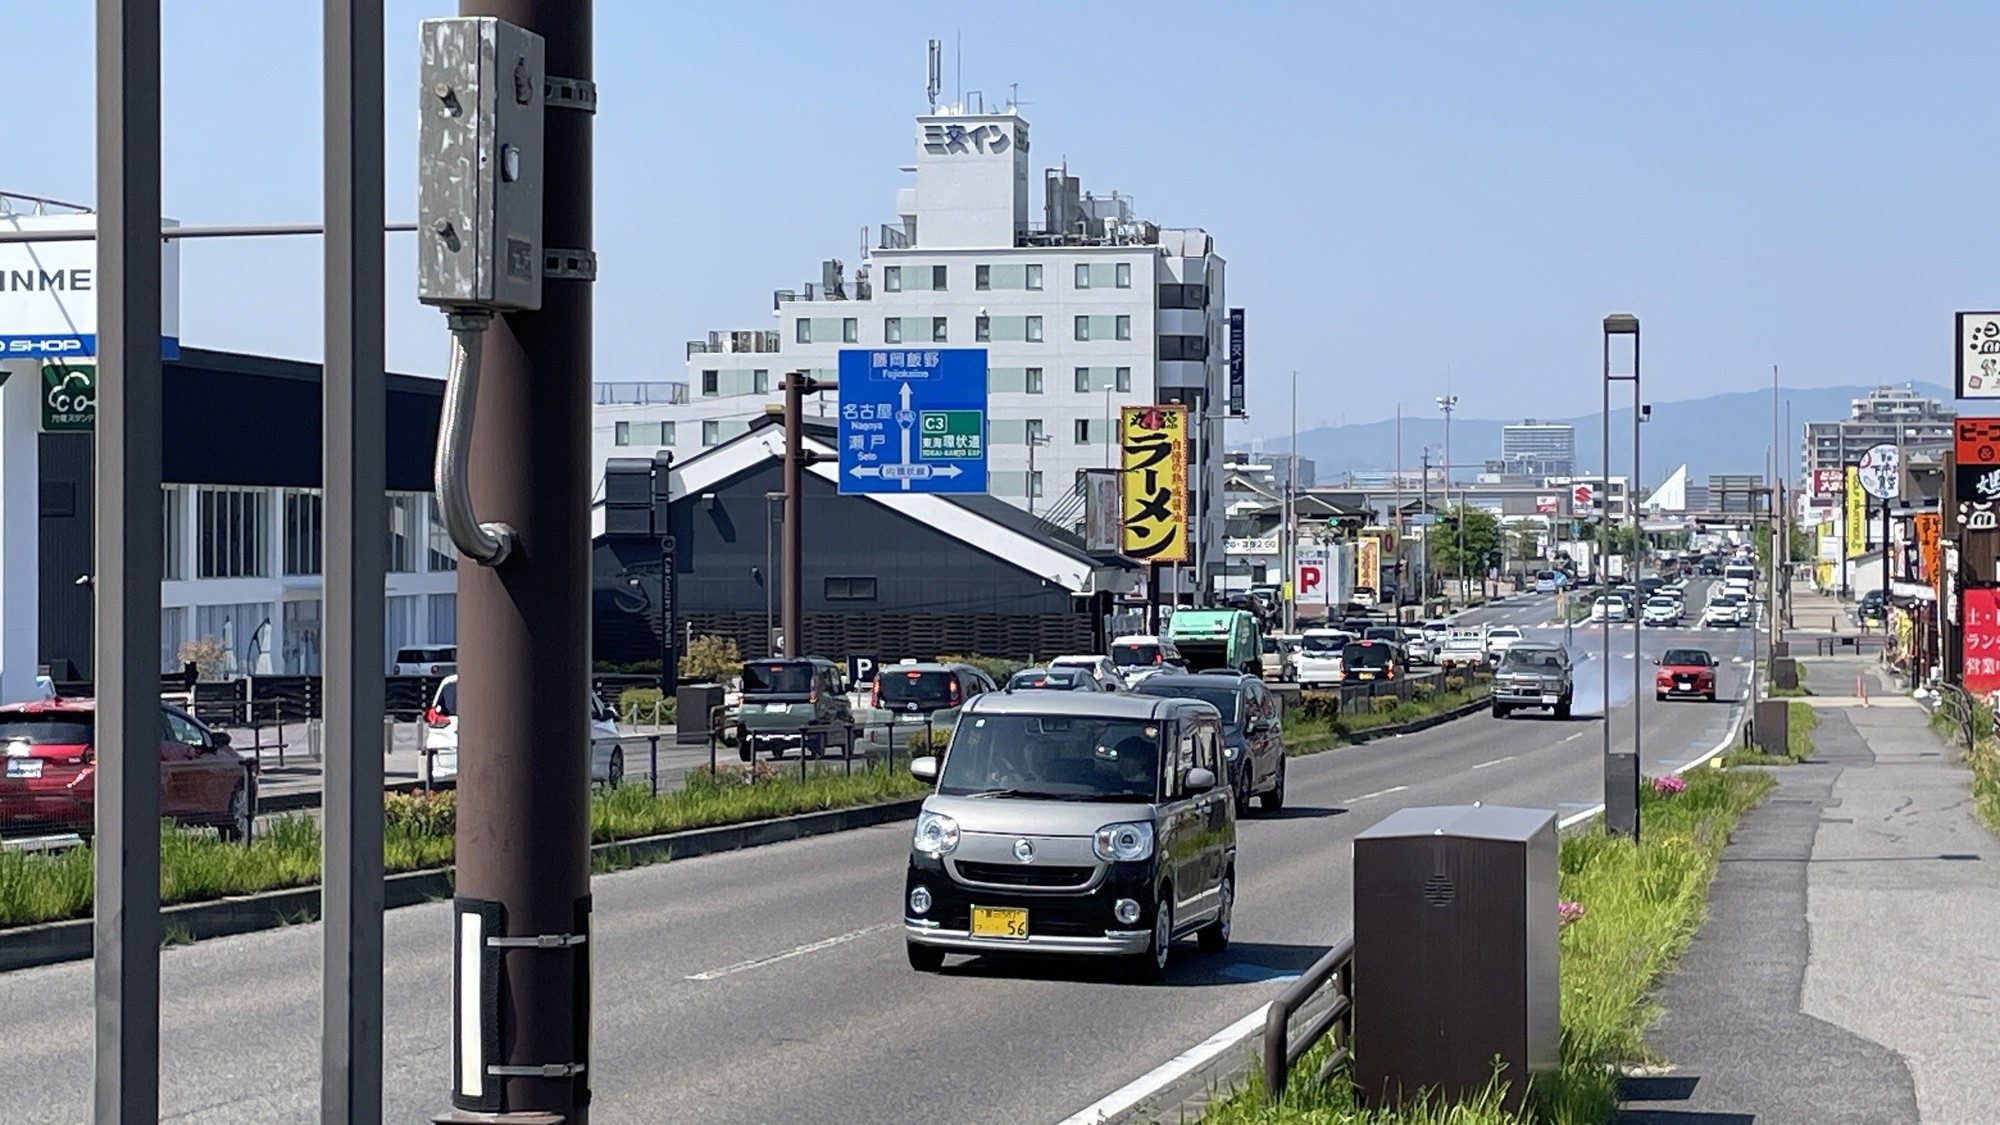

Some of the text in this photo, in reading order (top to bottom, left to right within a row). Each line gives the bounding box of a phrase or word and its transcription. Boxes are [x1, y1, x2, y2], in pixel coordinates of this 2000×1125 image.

[924, 124, 1011, 155] 三交イン
[9, 340, 81, 352] SHOP
[843, 404, 892, 420] 名古屋
[851, 422, 883, 431] Nagoya
[925, 417, 944, 430] C3
[849, 435, 886, 450] 瀬戸
[857, 451, 877, 461] Seto
[1123, 432, 1178, 559] ラーメン
[1301, 567, 1321, 594] P
[857, 658, 873, 679] P
[1007, 920, 1025, 937] 56
